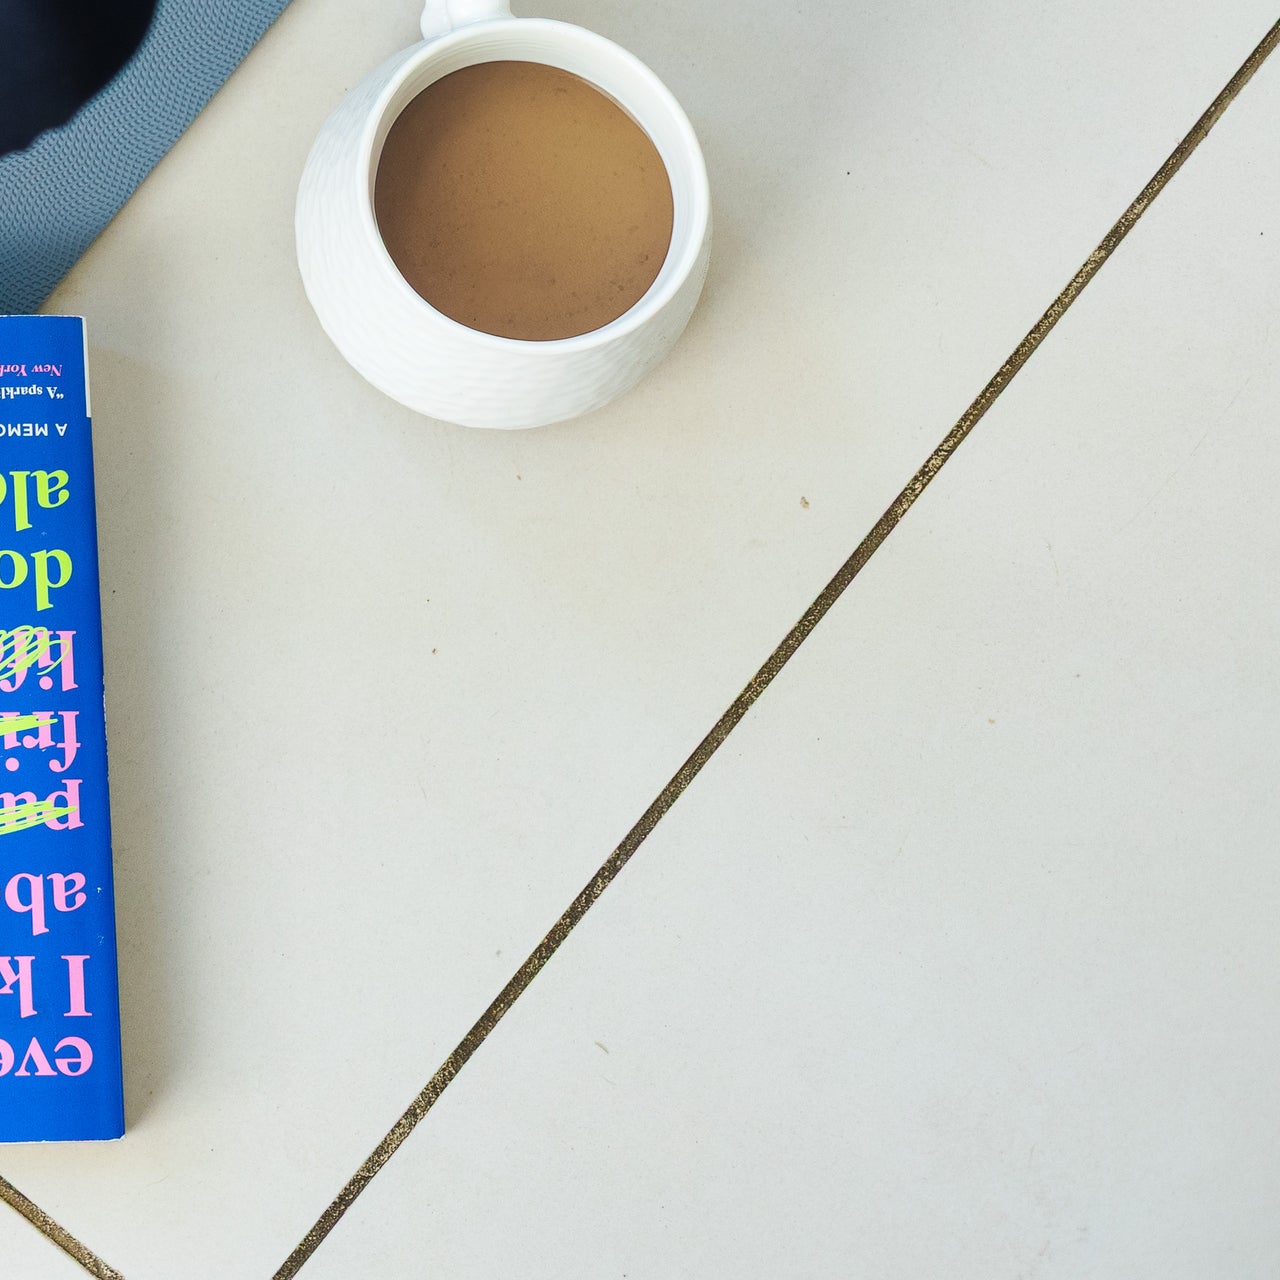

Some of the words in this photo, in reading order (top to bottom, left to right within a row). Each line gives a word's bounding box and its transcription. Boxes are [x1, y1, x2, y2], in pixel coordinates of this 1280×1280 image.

[32, 364, 62, 377] New
[55, 423, 68, 437] A
[61, 955, 93, 1017] I
